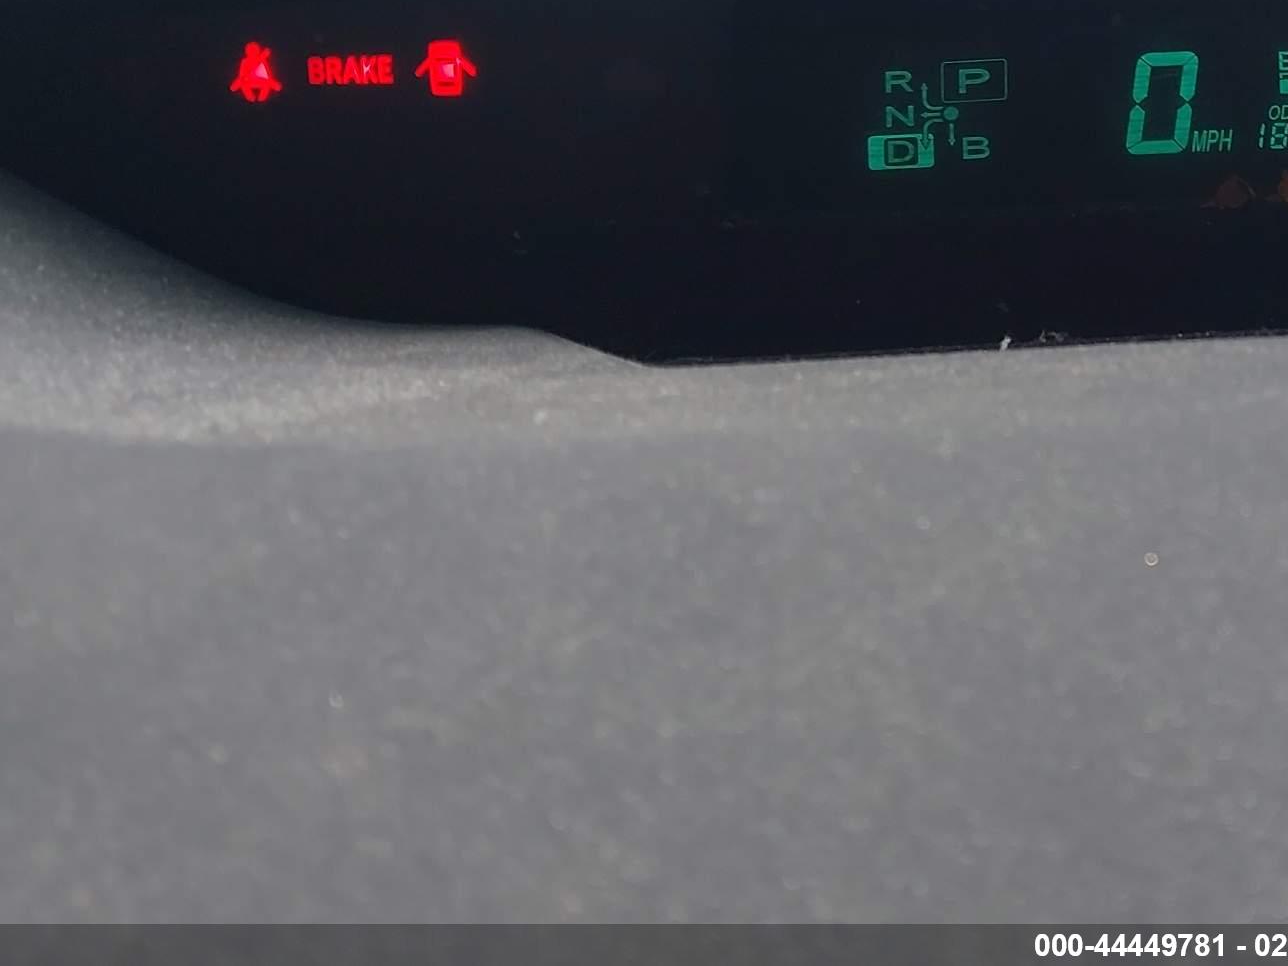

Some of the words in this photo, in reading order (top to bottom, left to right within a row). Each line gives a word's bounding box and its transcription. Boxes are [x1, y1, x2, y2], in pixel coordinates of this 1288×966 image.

[307, 54, 394, 85] BRAKE
[885, 70, 914, 93] R
[958, 68, 990, 94] P
[1126, 51, 1200, 154] 0
[1191, 129, 1233, 153] MPH
[885, 105, 915, 128] N
[888, 138, 915, 163] D
[962, 136, 990, 160] B
